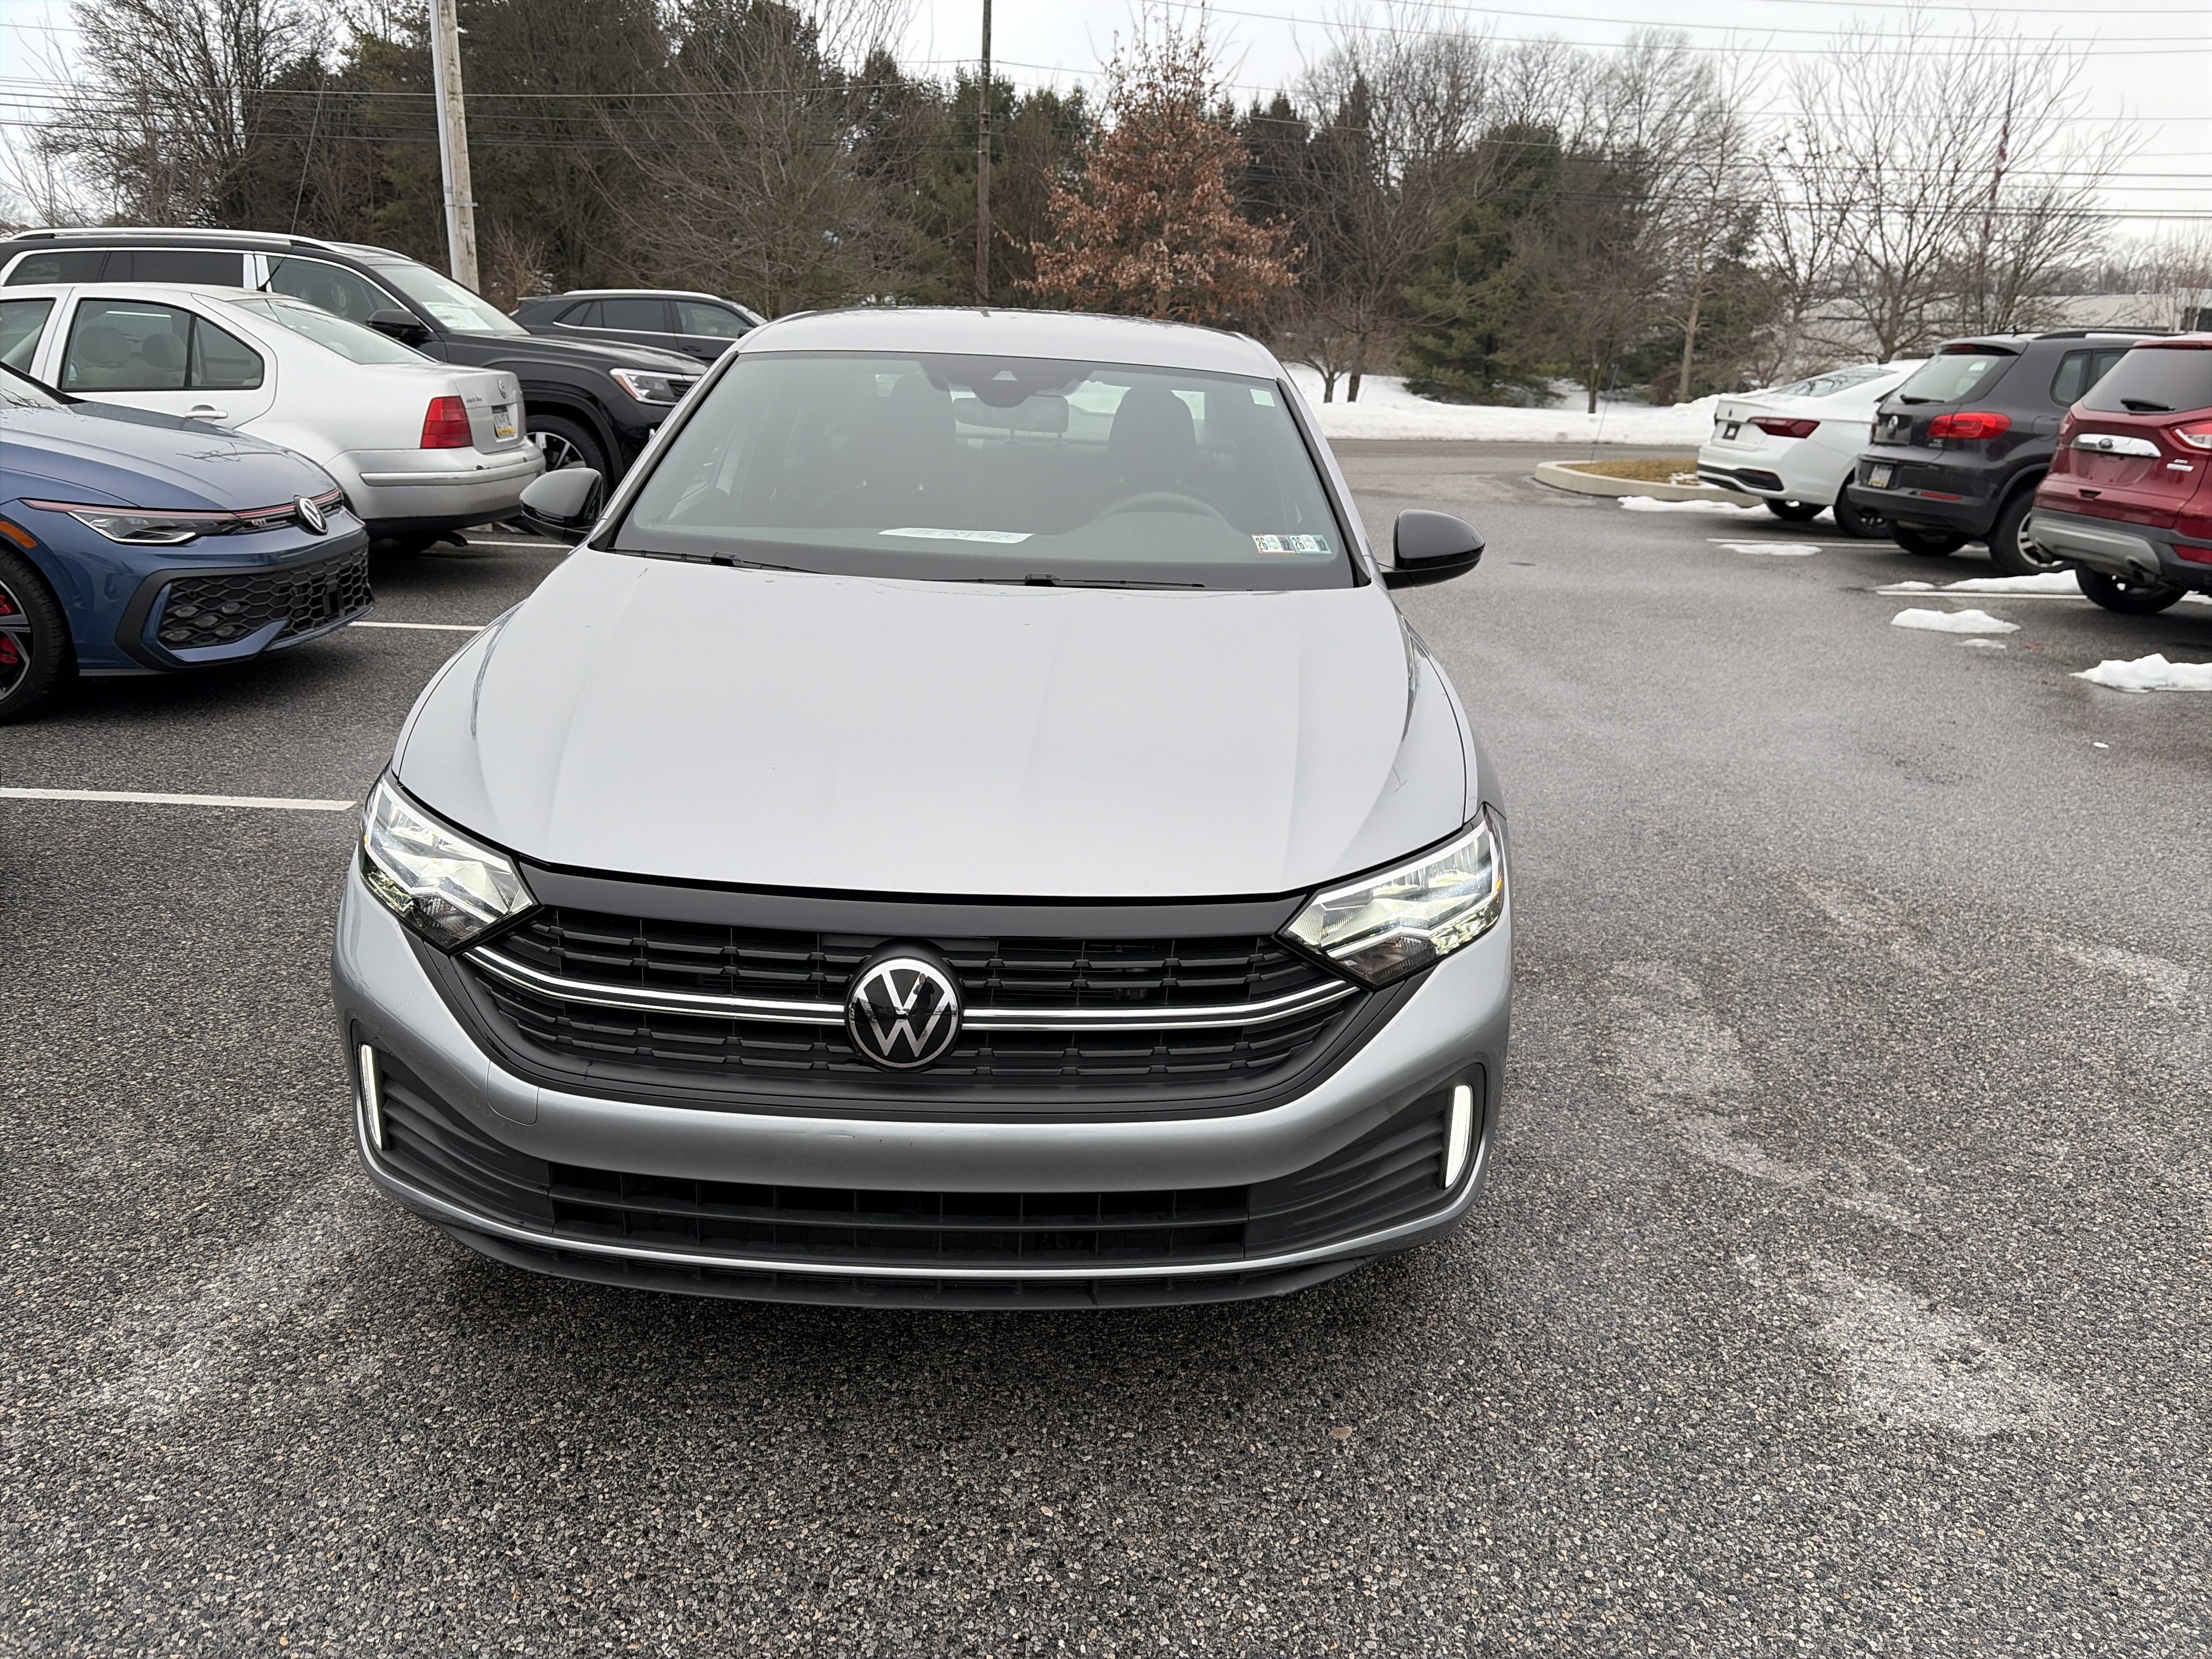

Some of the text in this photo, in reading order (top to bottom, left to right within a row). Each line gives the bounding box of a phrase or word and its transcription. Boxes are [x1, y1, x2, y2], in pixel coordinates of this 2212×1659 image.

[1255, 537, 1293, 551] 26 12
[1292, 537, 1328, 551] 26 12
[852, 964, 955, 1060] VW
